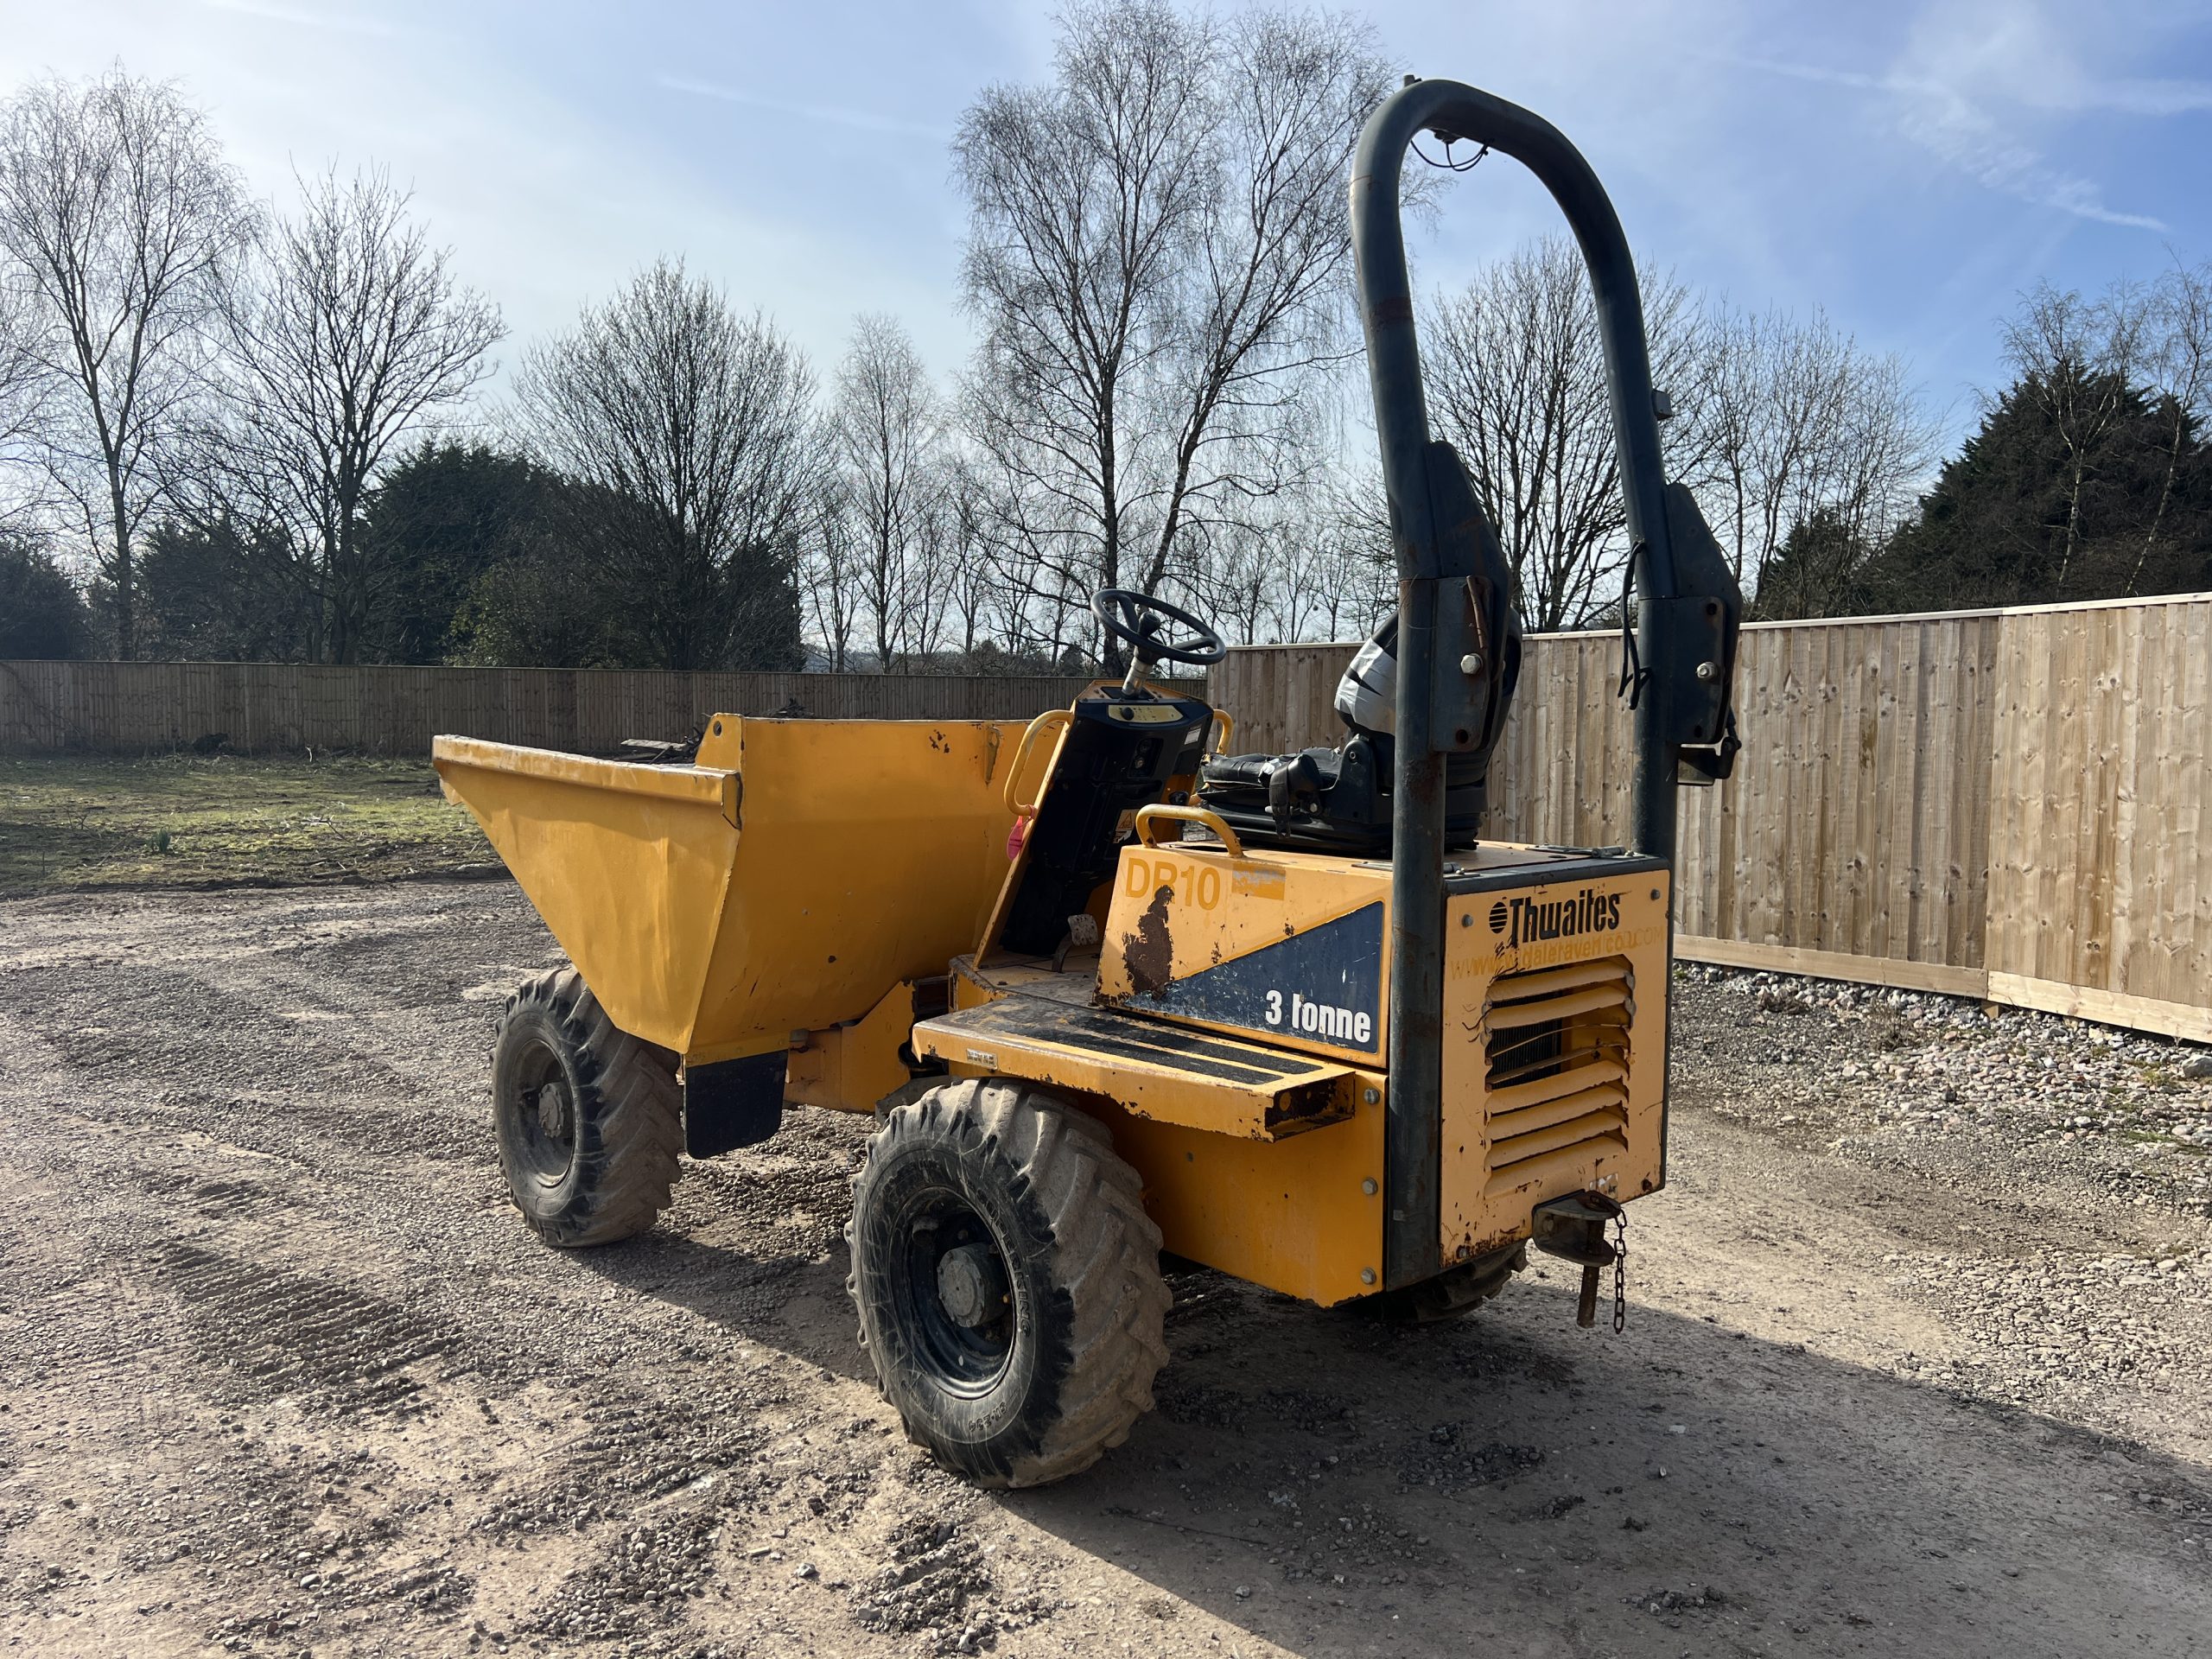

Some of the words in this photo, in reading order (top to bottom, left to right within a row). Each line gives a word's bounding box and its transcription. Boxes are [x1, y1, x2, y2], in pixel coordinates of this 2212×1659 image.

[1125, 857, 1221, 911] DR10
[1510, 888, 1621, 949] Thwaites
[1265, 989, 1283, 1026] 3
[1291, 993, 1371, 1043] tonne
